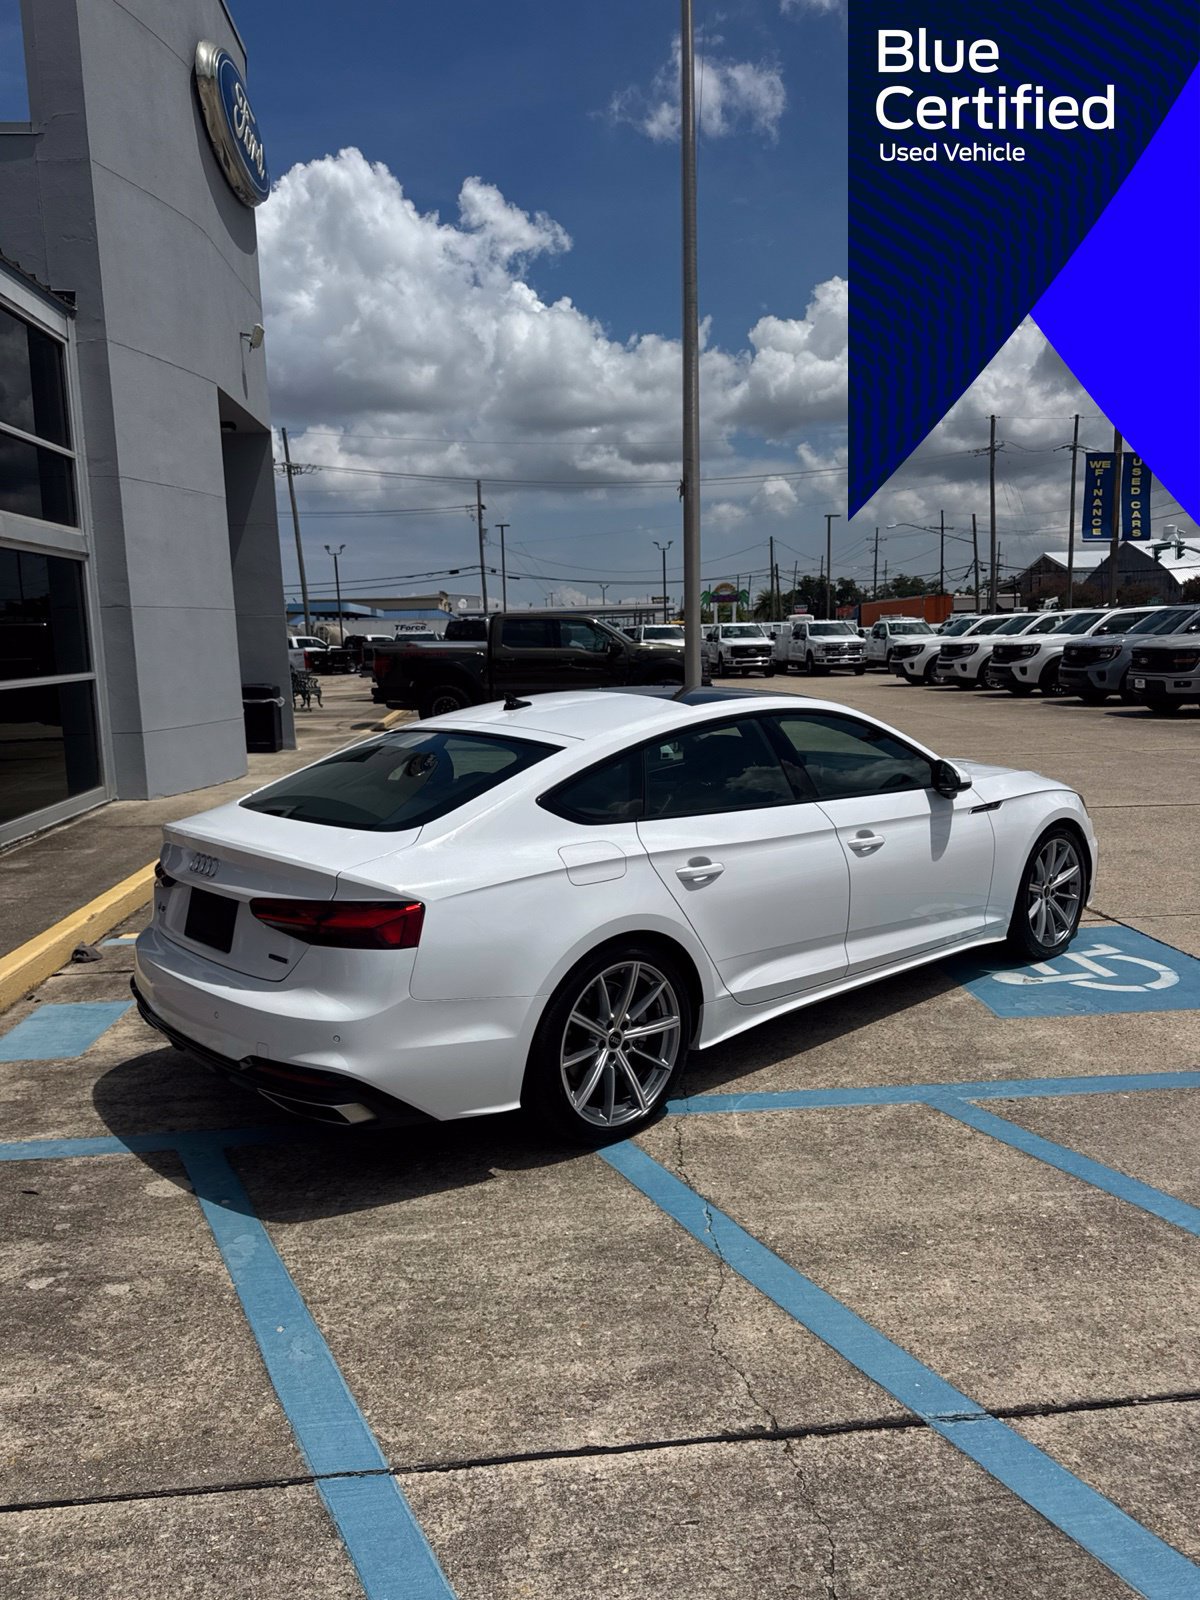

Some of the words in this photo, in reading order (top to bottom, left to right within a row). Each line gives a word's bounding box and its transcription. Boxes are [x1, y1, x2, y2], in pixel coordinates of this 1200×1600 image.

[233, 82, 265, 180] Ford
[1089, 460, 1111, 468] WE
[1131, 458, 1142, 495] USED
[1092, 469, 1104, 535] FINANCE
[1131, 501, 1142, 537] CARS
